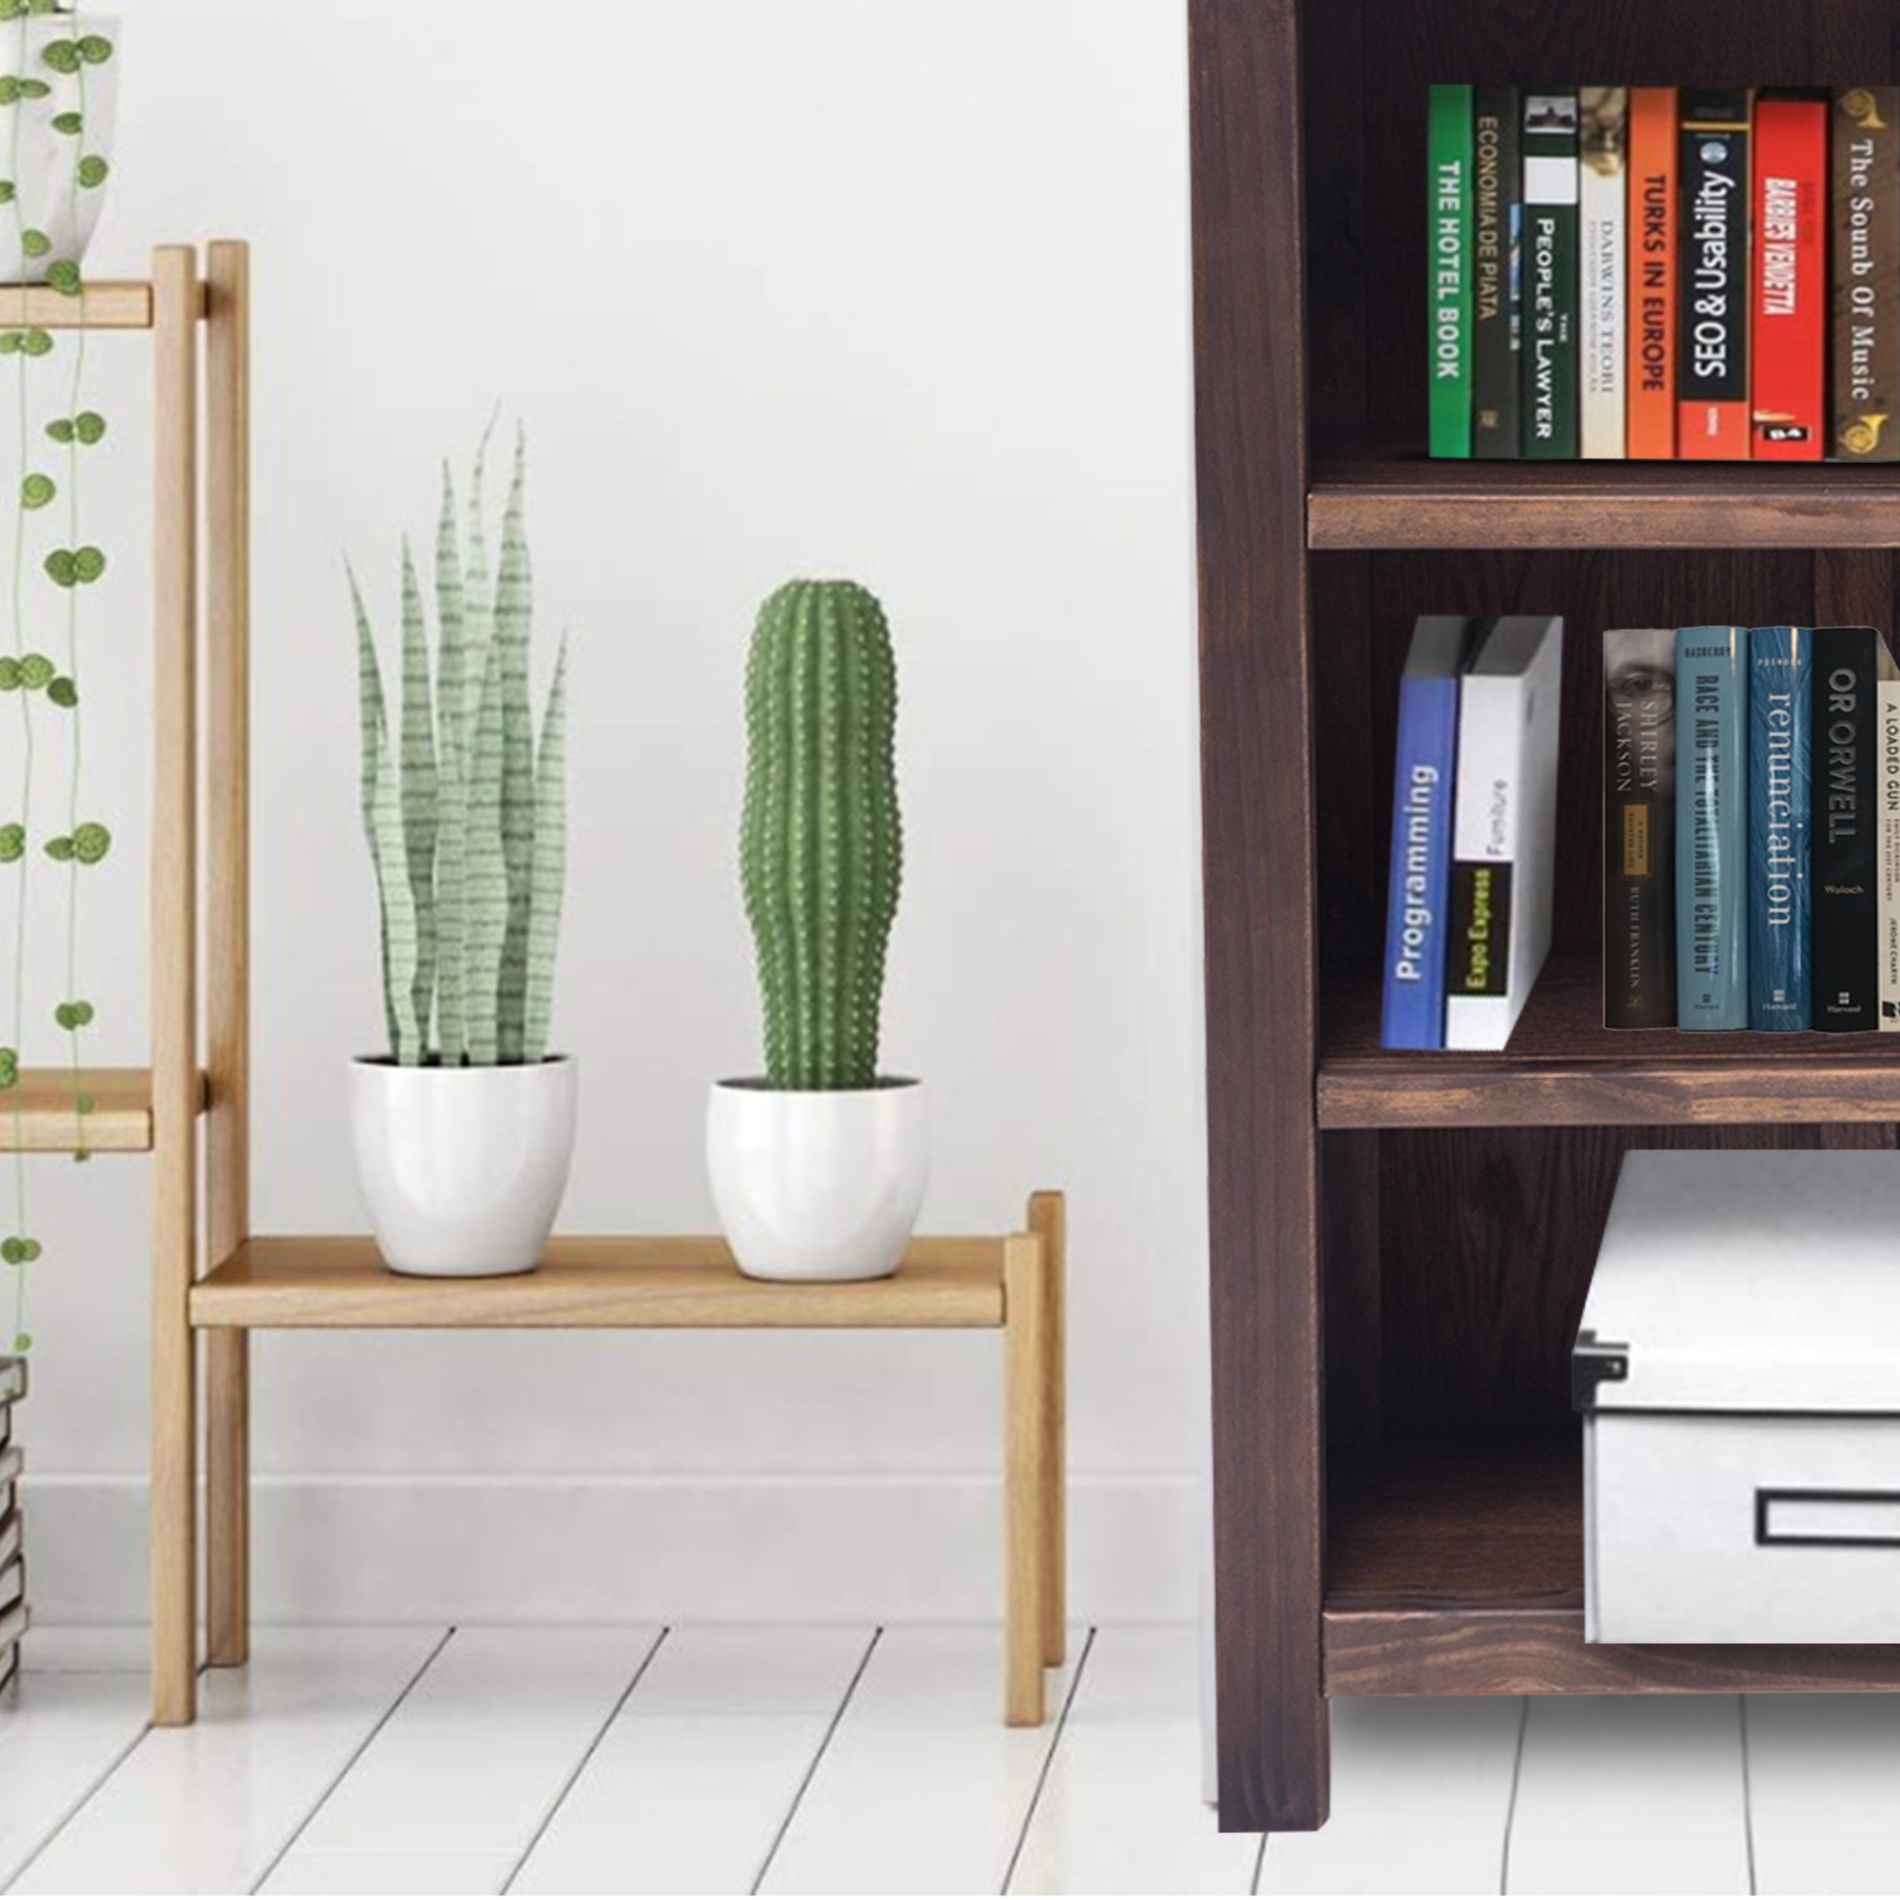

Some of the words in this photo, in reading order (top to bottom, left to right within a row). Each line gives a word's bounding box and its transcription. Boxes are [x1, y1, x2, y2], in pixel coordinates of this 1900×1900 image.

[1439, 161, 1460, 209] THE
[1479, 116, 1498, 226] ECONOMIA
[1851, 140, 1872, 187] The
[1479, 231, 1498, 256] DE
[1644, 175, 1666, 252] TURKS
[1694, 171, 1734, 289] Usability
[1438, 218, 1459, 299] HOTEL
[1480, 262, 1498, 319] PIATA
[1536, 218, 1554, 331] PEOPLE'S
[1600, 220, 1613, 322] DARWINS
[1644, 262, 1664, 287] IN
[1763, 243, 1796, 315] VENDETTA
[1696, 295, 1724, 316] &
[1852, 286, 1874, 314] Of
[1438, 307, 1458, 378] BOOK
[1601, 330, 1613, 392] TEORI
[1644, 298, 1664, 391] EUROPE
[1694, 322, 1726, 377] SEO
[1851, 326, 1873, 399] Music
[1536, 339, 1552, 438] LAWYER
[1695, 675, 1719, 713] RACE
[1828, 668, 1857, 713] OR
[1886, 703, 1898, 713] A
[1615, 700, 1632, 793] JACKSON
[1639, 700, 1657, 792] SHIRLEY
[1695, 719, 1719, 748] AND
[1695, 755, 1719, 782] THE
[1886, 718, 1899, 773] LOADED
[1487, 780, 1508, 855] Furniture
[1768, 692, 1803, 927] renunciation
[1828, 721, 1857, 843] ORWELL
[1887, 780, 1899, 811] GUN
[1395, 764, 1439, 981] Programming
[1695, 788, 1719, 897] TOTALITARIAN
[1468, 869, 1492, 940] Express
[1629, 887, 1641, 920] RUTH
[1694, 903, 1720, 975] CENTURY
[1466, 942, 1490, 988] Expo
[1629, 925, 1640, 988] FRANKLIN
